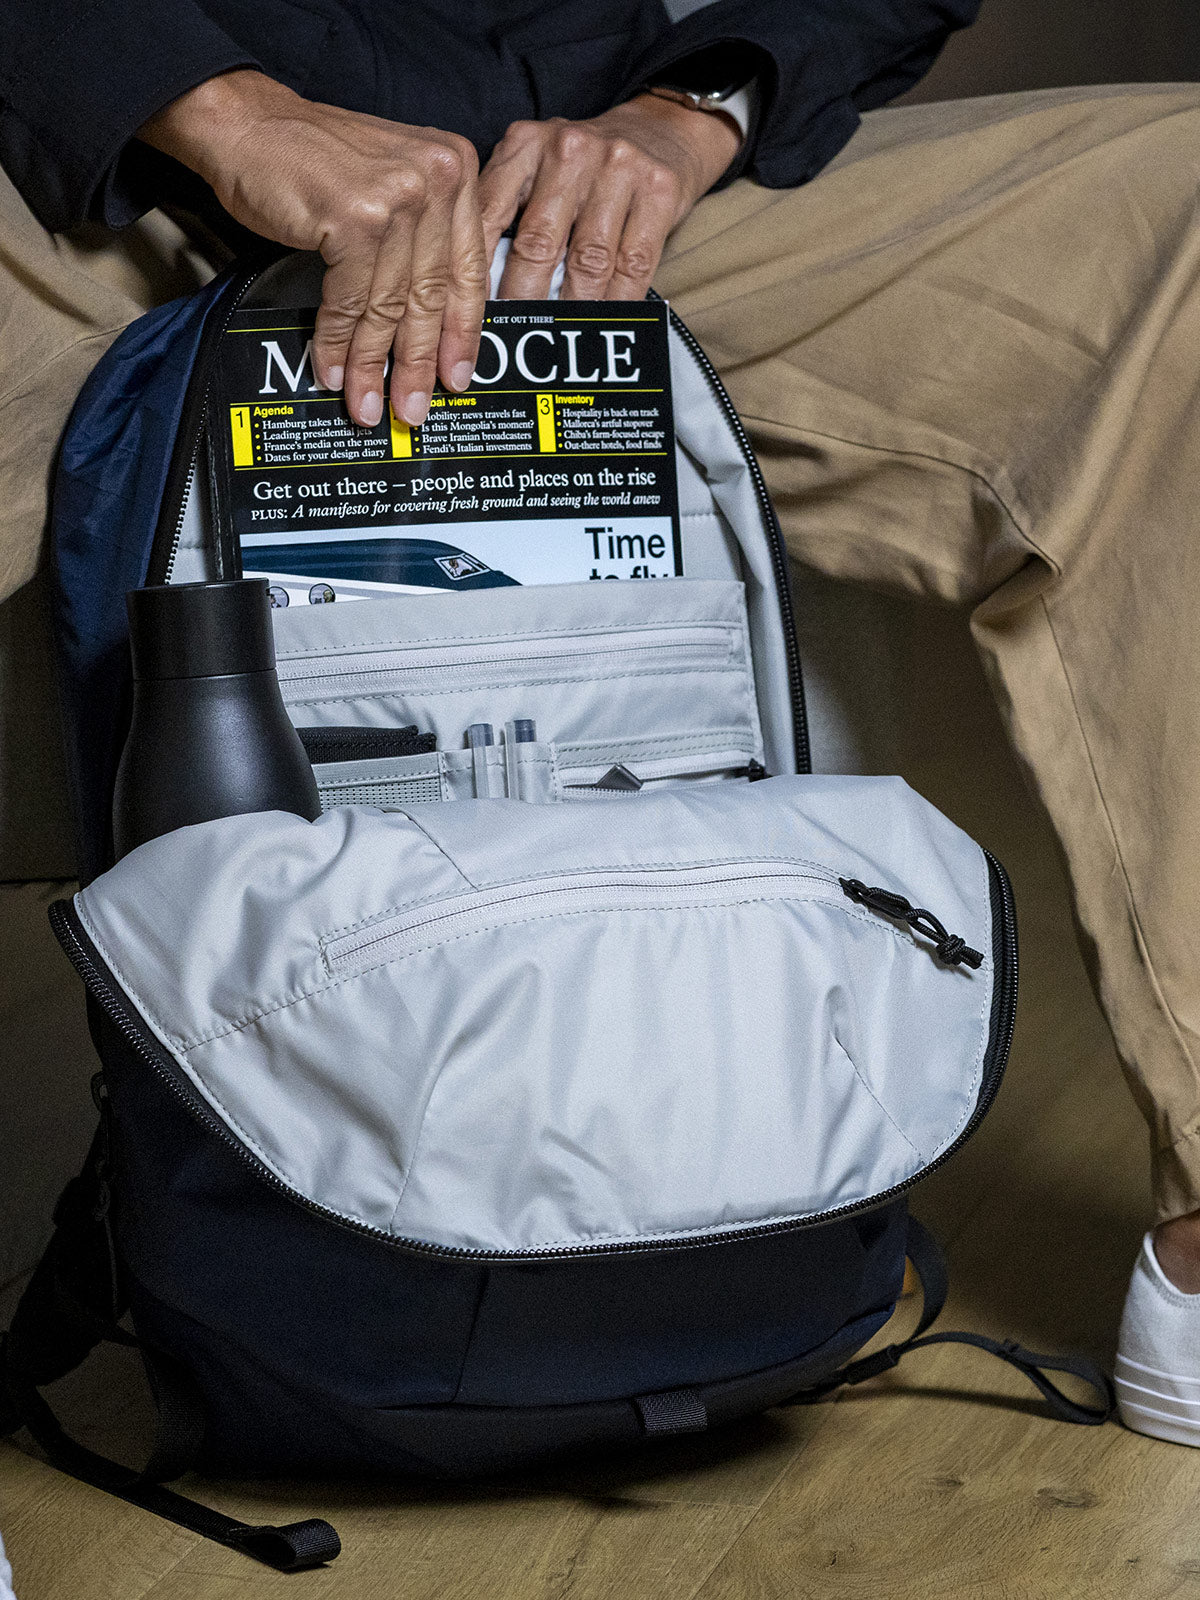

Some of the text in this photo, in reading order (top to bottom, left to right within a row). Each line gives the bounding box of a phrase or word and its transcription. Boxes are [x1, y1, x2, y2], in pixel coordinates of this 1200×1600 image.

[493, 316, 509, 324] GET
[510, 316, 528, 324] OUT
[529, 316, 554, 324] THERE
[259, 330, 640, 394] MOCLE
[448, 397, 477, 407] views
[555, 394, 595, 405] Inventory
[254, 406, 294, 417] Agenda
[540, 398, 550, 415] 3
[485, 410, 511, 418] travels
[512, 409, 526, 418] fast
[562, 409, 602, 418] Hospitality
[603, 409, 611, 417] is
[611, 409, 629, 417] back
[640, 408, 659, 416] track
[235, 411, 244, 428] 1
[262, 420, 306, 431] Hamburg
[308, 419, 335, 428] takes
[563, 419, 654, 429] Mallorca's artful stopover
[431, 422, 448, 432] this
[450, 421, 496, 431] Mongolia's
[498, 421, 534, 429] moment?
[263, 428, 372, 441] Leading presidential jets
[422, 431, 532, 444] Brave Iranian broadcasters
[564, 430, 665, 440] Chiba's farm-focused escape
[264, 441, 301, 452] France's
[303, 441, 332, 449] media
[347, 439, 363, 448] the
[364, 438, 388, 447] move
[423, 442, 532, 454] Fendi's Italian investments
[564, 440, 662, 450] Out-there hotels, food finds
[264, 448, 385, 463] Dates for your design diary
[254, 481, 292, 500] Get
[298, 482, 331, 498] out
[336, 477, 388, 496] there
[411, 471, 474, 494] people
[480, 469, 514, 488] and
[519, 469, 569, 492] places
[573, 472, 593, 486] on
[597, 467, 624, 486] the
[627, 467, 656, 485] rise
[251, 491, 661, 520] PLUS: A manifesto for covering fresh ground and seeing the world anew
[584, 526, 666, 560] Time
